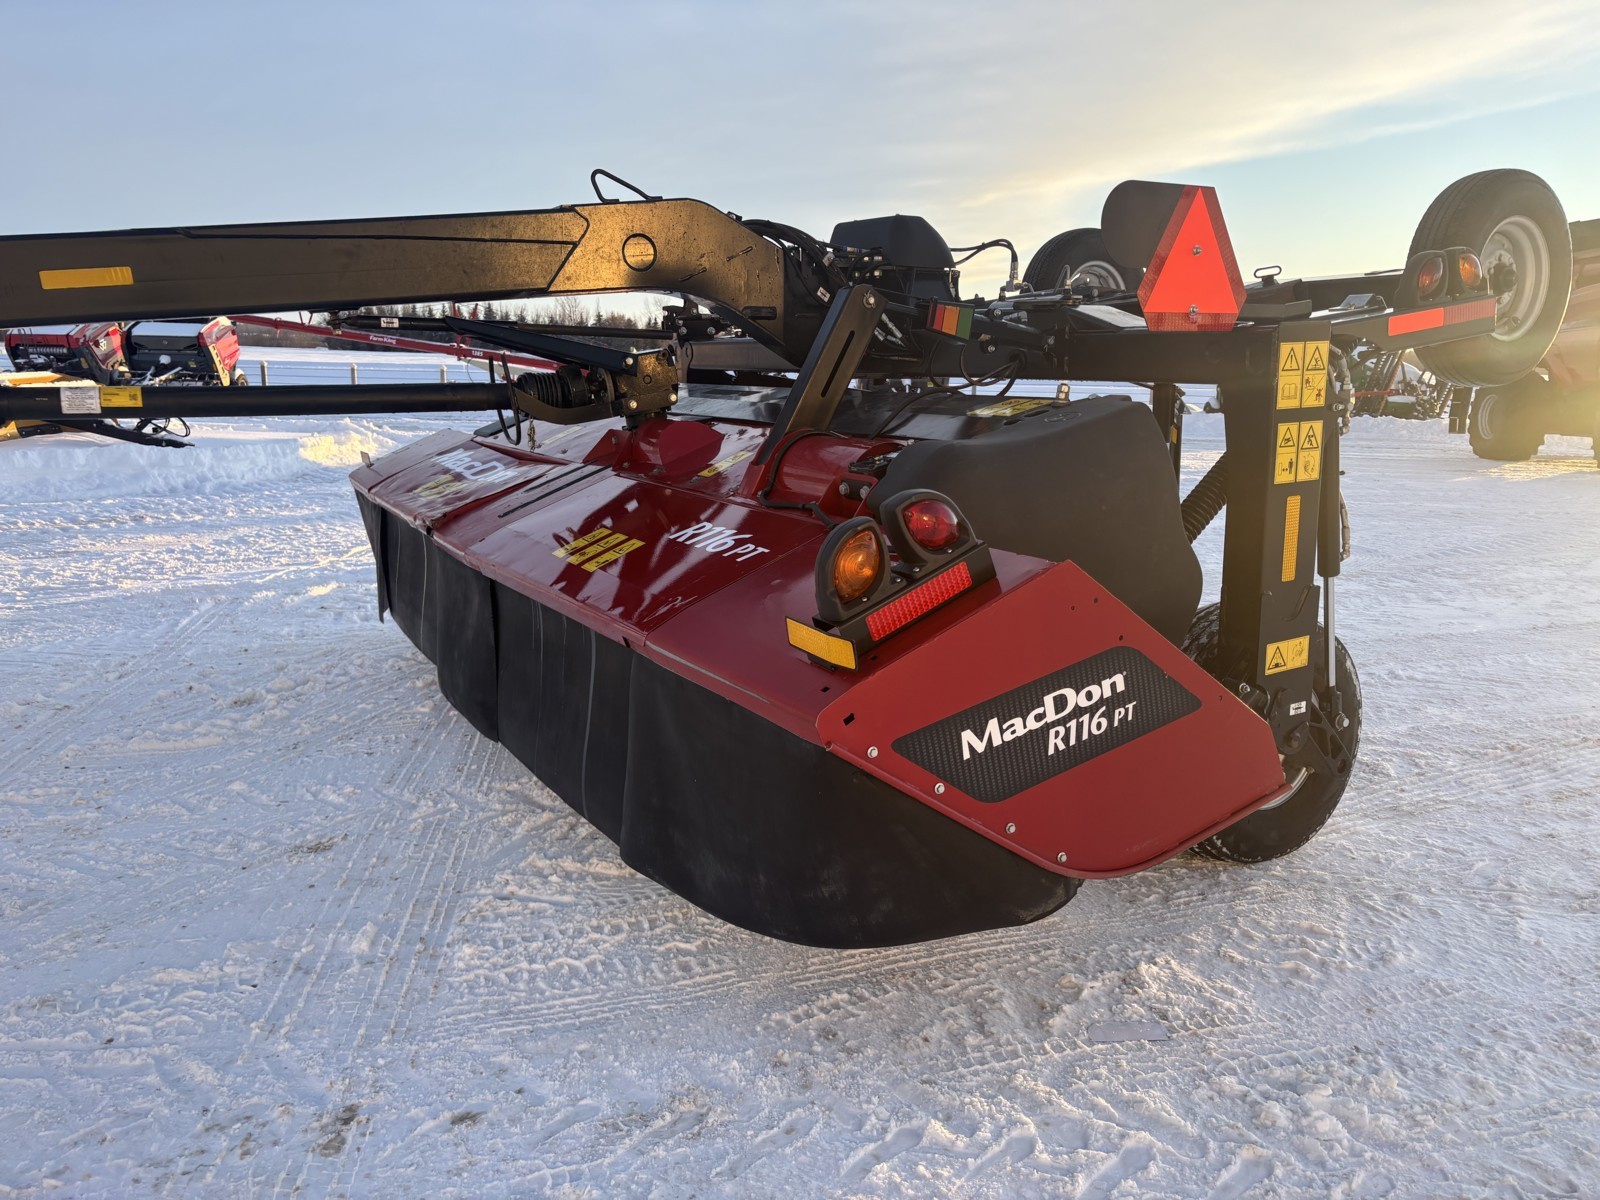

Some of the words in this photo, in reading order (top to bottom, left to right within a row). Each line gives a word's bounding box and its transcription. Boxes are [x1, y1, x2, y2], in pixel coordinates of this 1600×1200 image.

[668, 521, 753, 553] R116
[722, 543, 770, 562] PT
[961, 673, 1126, 761] MacDon
[1048, 706, 1107, 756] R116
[1113, 701, 1137, 728] PT
